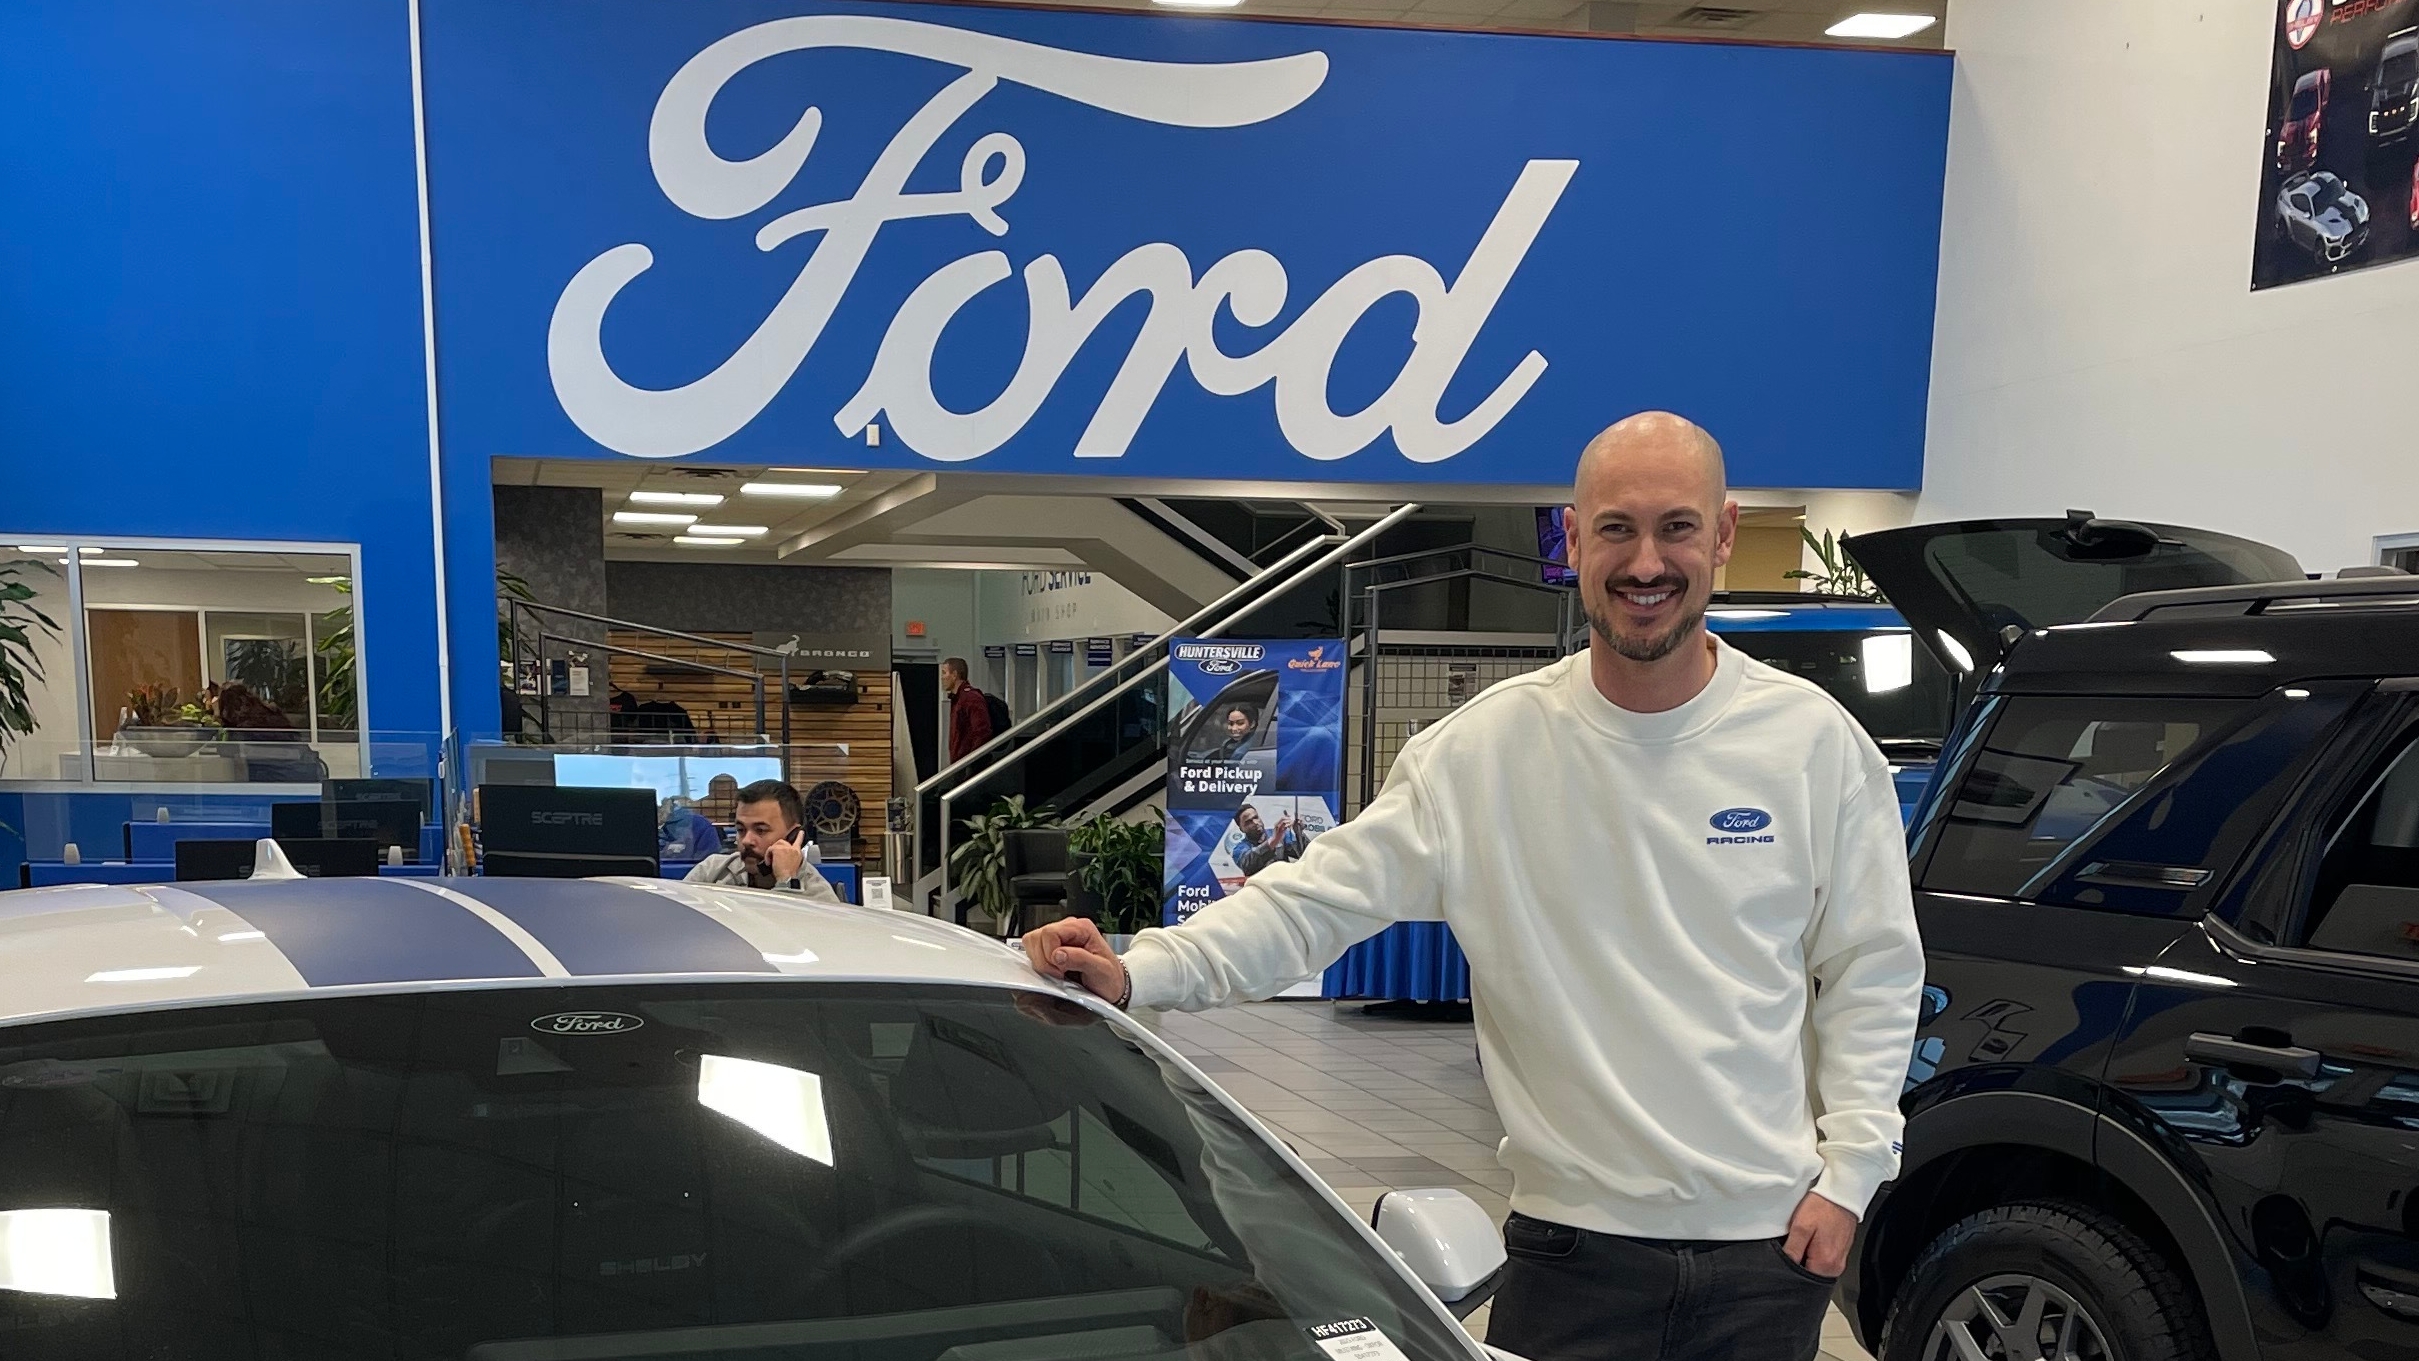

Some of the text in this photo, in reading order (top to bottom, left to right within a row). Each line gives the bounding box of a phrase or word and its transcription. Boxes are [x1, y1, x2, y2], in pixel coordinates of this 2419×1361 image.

[548, 14, 1580, 463] Ford
[800, 650, 870, 658] BRONCO
[1178, 646, 1261, 659] HUNTERSVILLE
[1205, 660, 1234, 672] Ford
[1287, 659, 1315, 669] Quick
[1180, 766, 1263, 782] Ford Pickup
[1184, 780, 1258, 796] & Delivery
[530, 811, 603, 826] SCEPTRE
[1723, 811, 1760, 828] Ford
[1706, 835, 1775, 845] RACING
[1177, 884, 1210, 897] Ford
[553, 1015, 624, 1032] Ford
